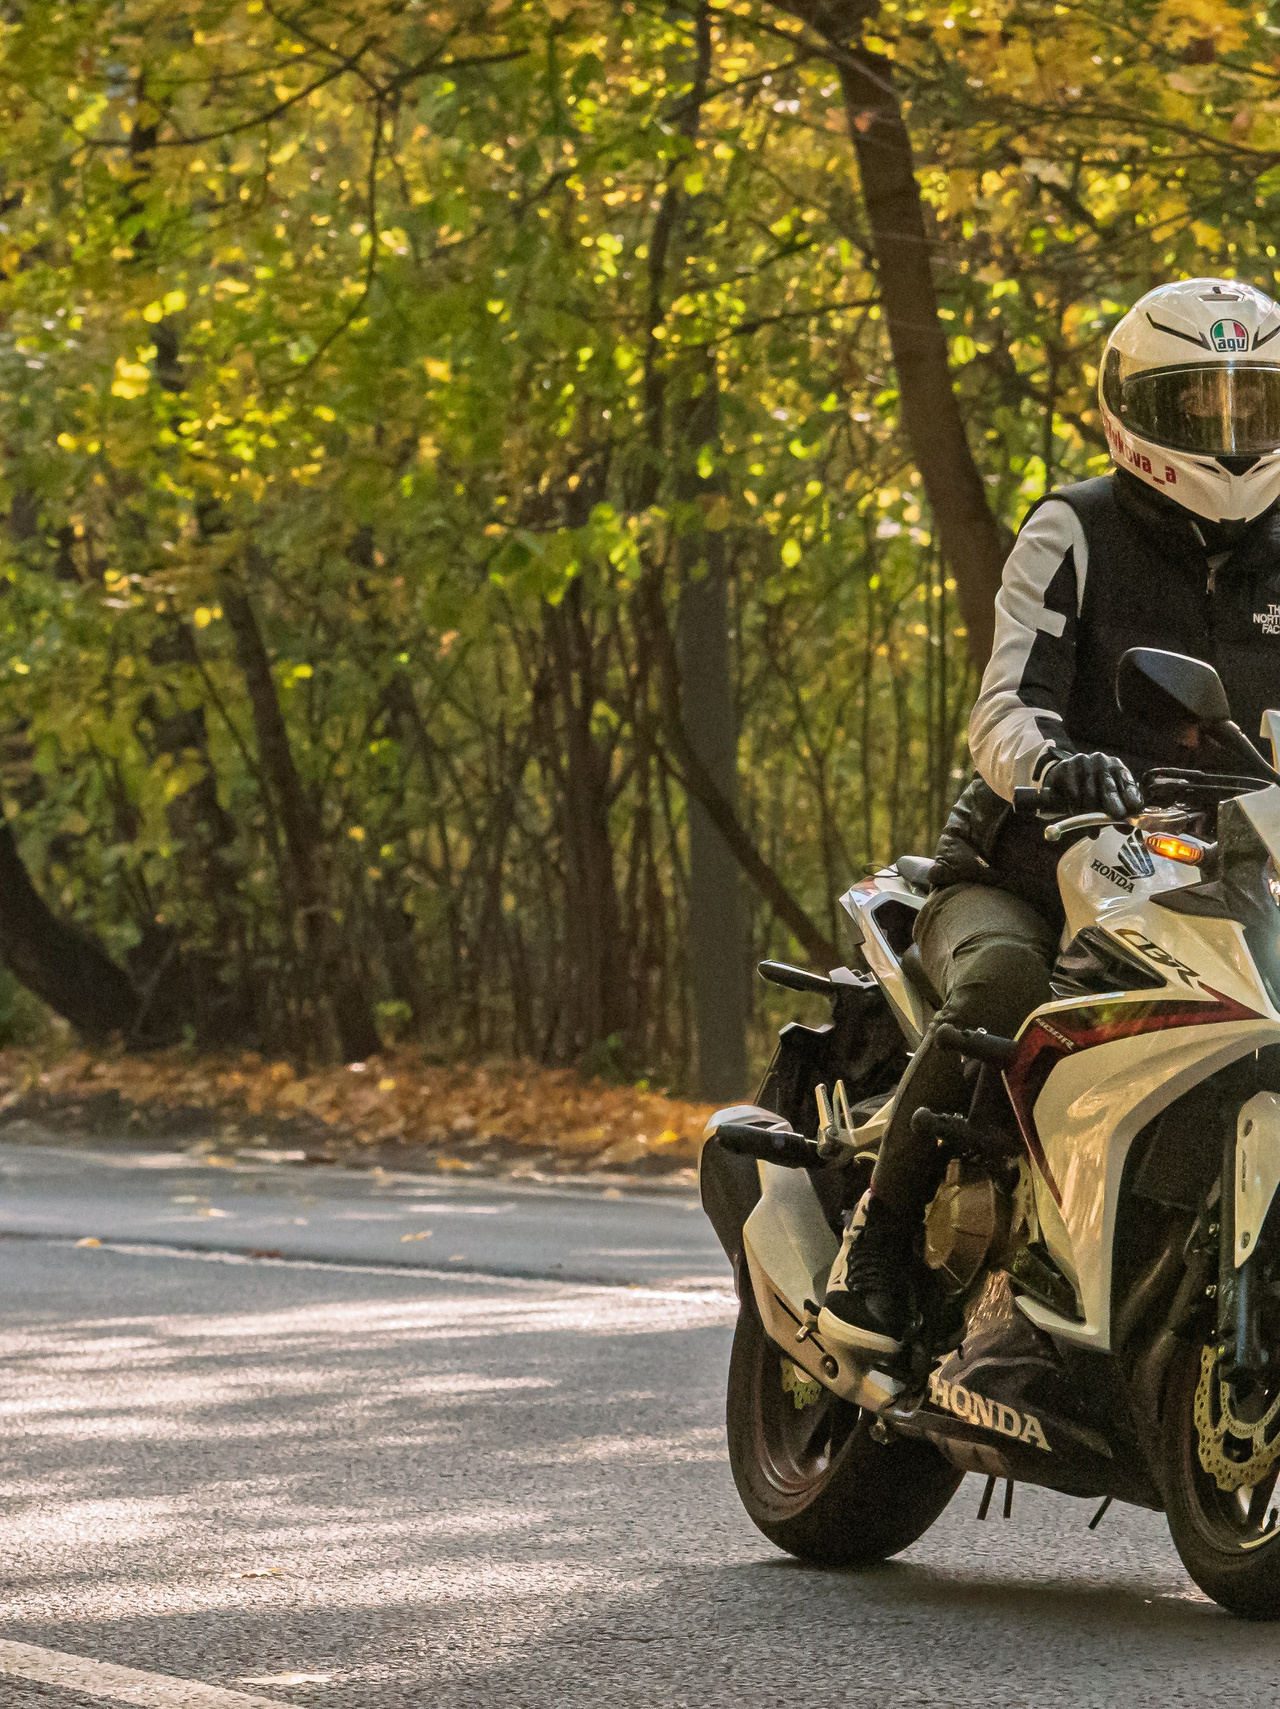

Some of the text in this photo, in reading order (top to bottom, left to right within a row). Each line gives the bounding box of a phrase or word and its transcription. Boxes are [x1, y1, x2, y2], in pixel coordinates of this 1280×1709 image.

[1090, 859, 1135, 893] HONDA
[1114, 928, 1200, 989] CBR
[929, 1373, 1052, 1451] HONDA
